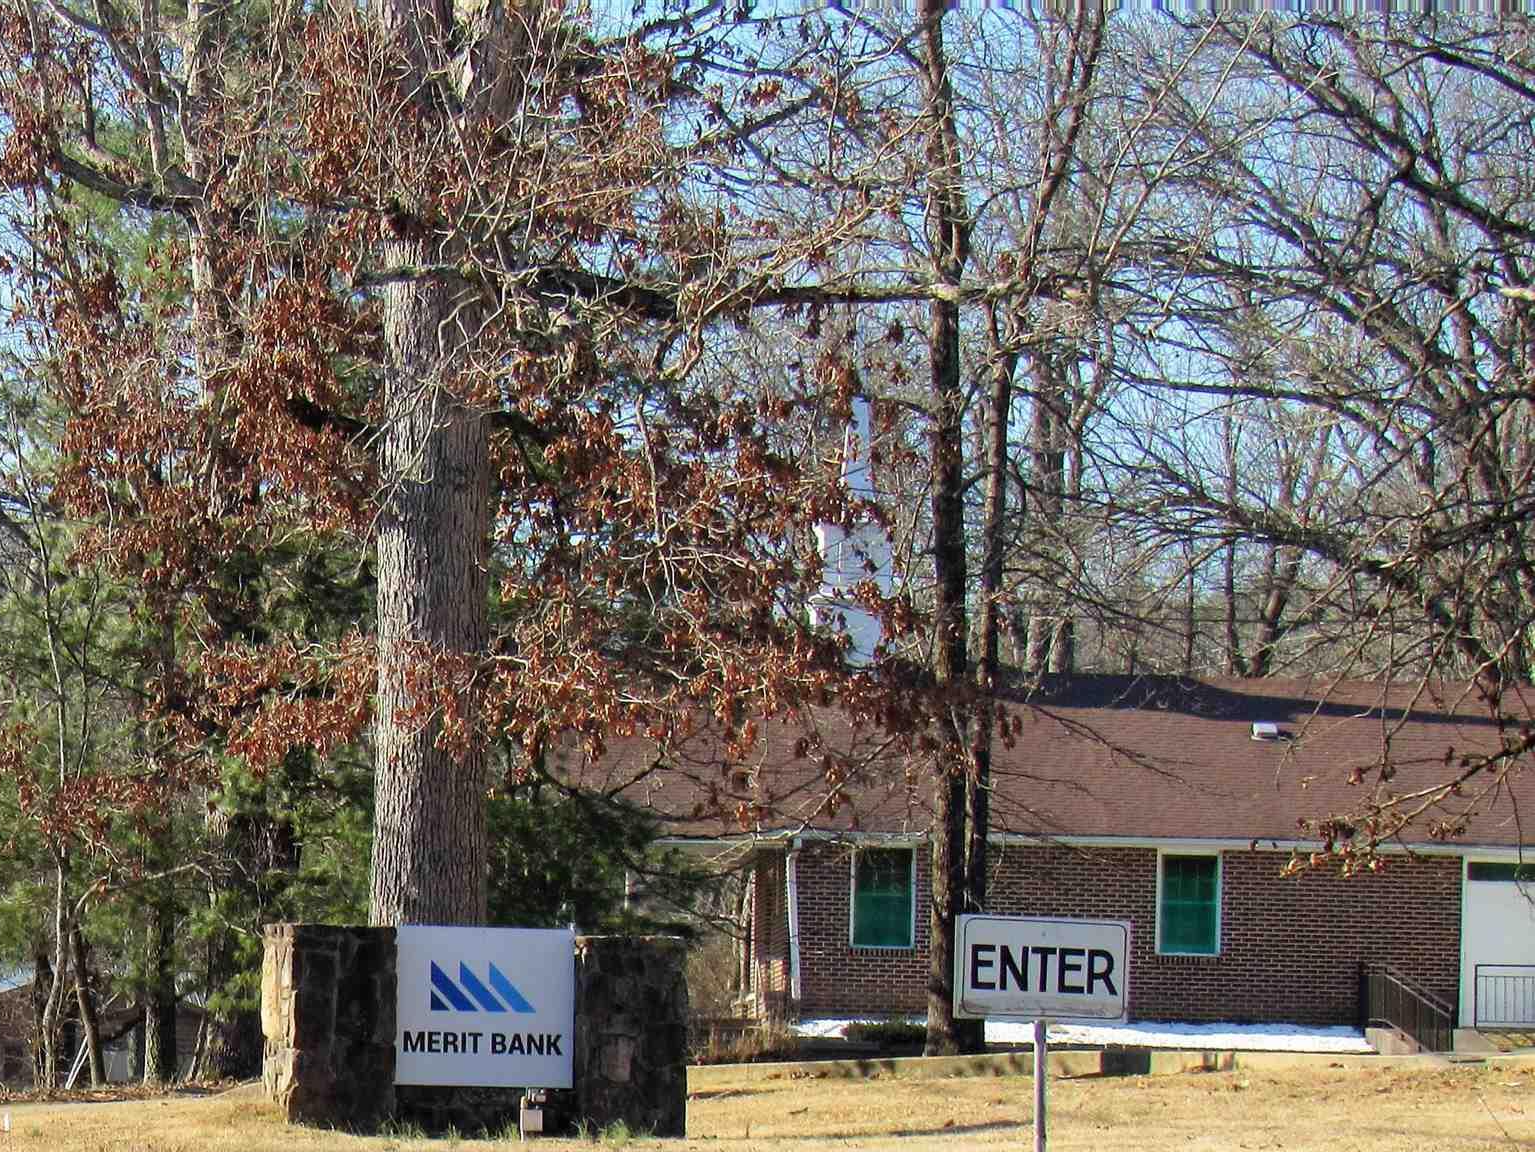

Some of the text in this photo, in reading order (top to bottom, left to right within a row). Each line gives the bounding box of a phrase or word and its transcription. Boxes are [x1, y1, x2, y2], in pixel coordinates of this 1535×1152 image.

[970, 943, 1119, 997] ENTER
[403, 1030, 564, 1057] MERIT BANK
